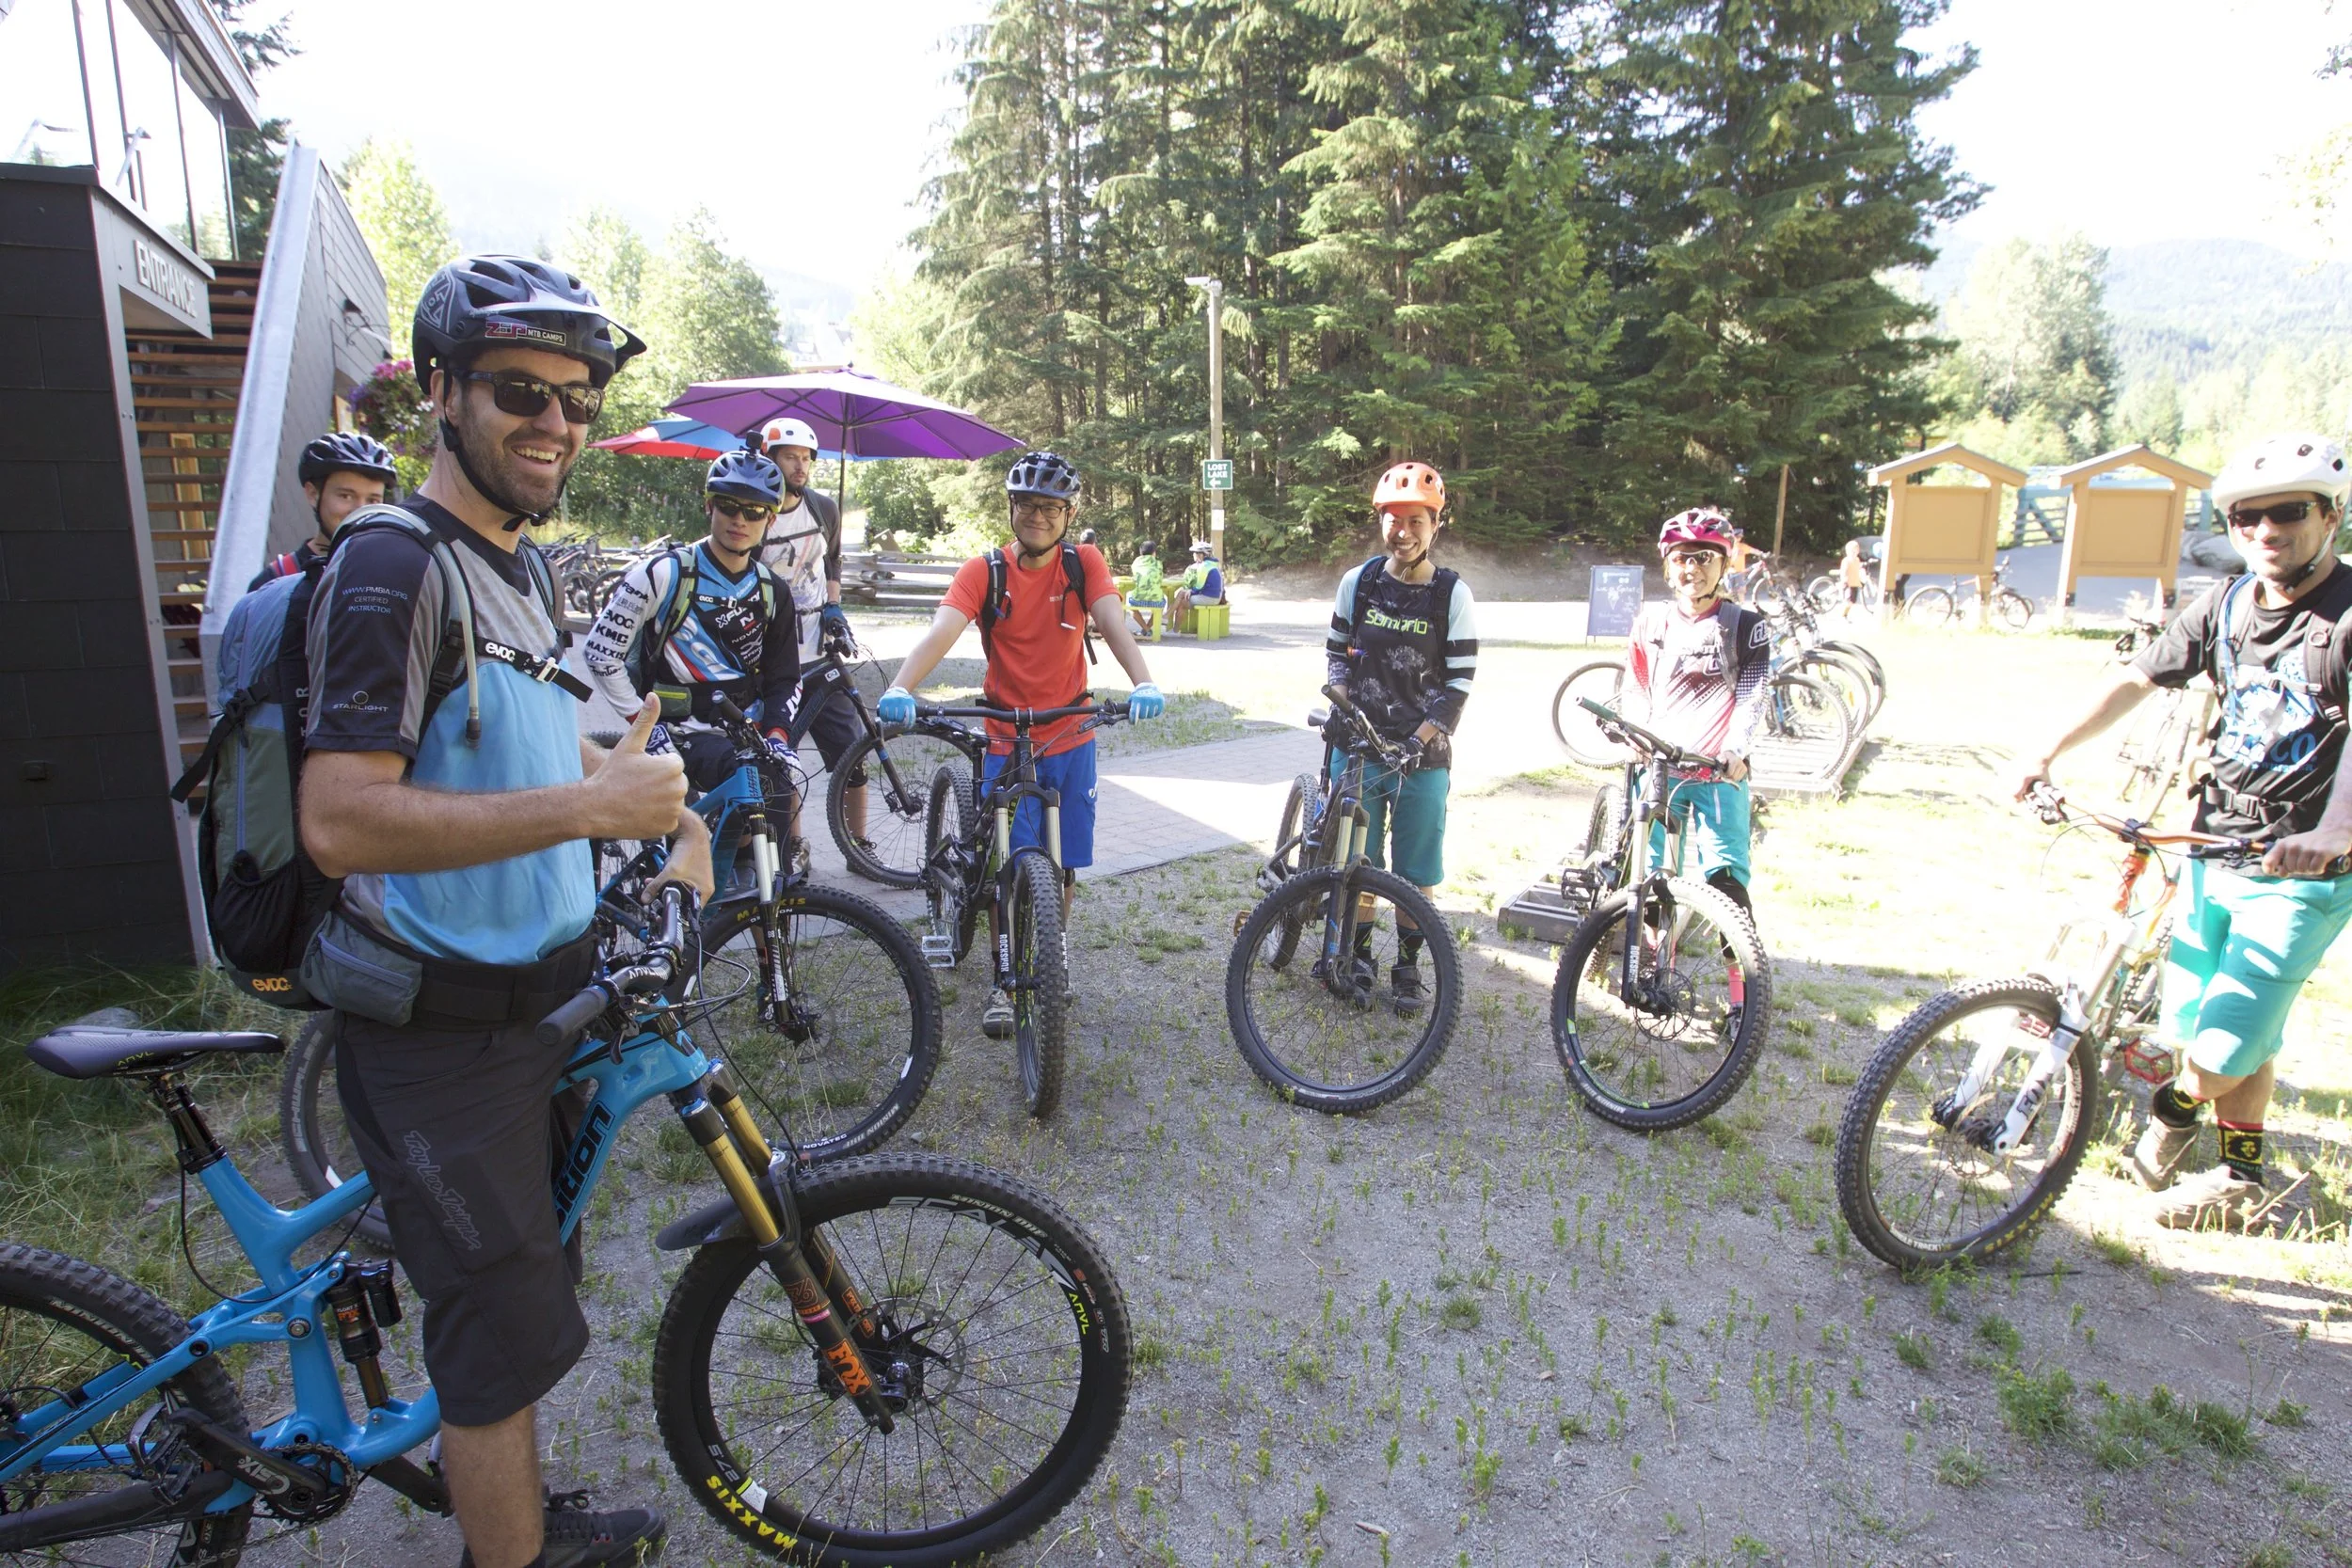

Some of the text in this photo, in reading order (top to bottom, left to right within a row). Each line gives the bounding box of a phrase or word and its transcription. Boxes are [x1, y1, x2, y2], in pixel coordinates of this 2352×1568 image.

[135, 239, 197, 318] ENTRANCE
[542, 332, 564, 342] CAMPS
[342, 586, 408, 600] WWW.PMBIA.ORG
[354, 595, 389, 604] CERTIFIED
[348, 605, 391, 614] INSTRUCTOR
[596, 623, 629, 644] KMC
[586, 640, 626, 660] MAXXIS
[332, 703, 389, 712] STARLIGHT
[803, 1133, 847, 1149] NOVATEC
[952, 1194, 1013, 1218] MINION
[827, 1341, 871, 1395] FOX
[707, 1475, 799, 1549] MAXXIS
